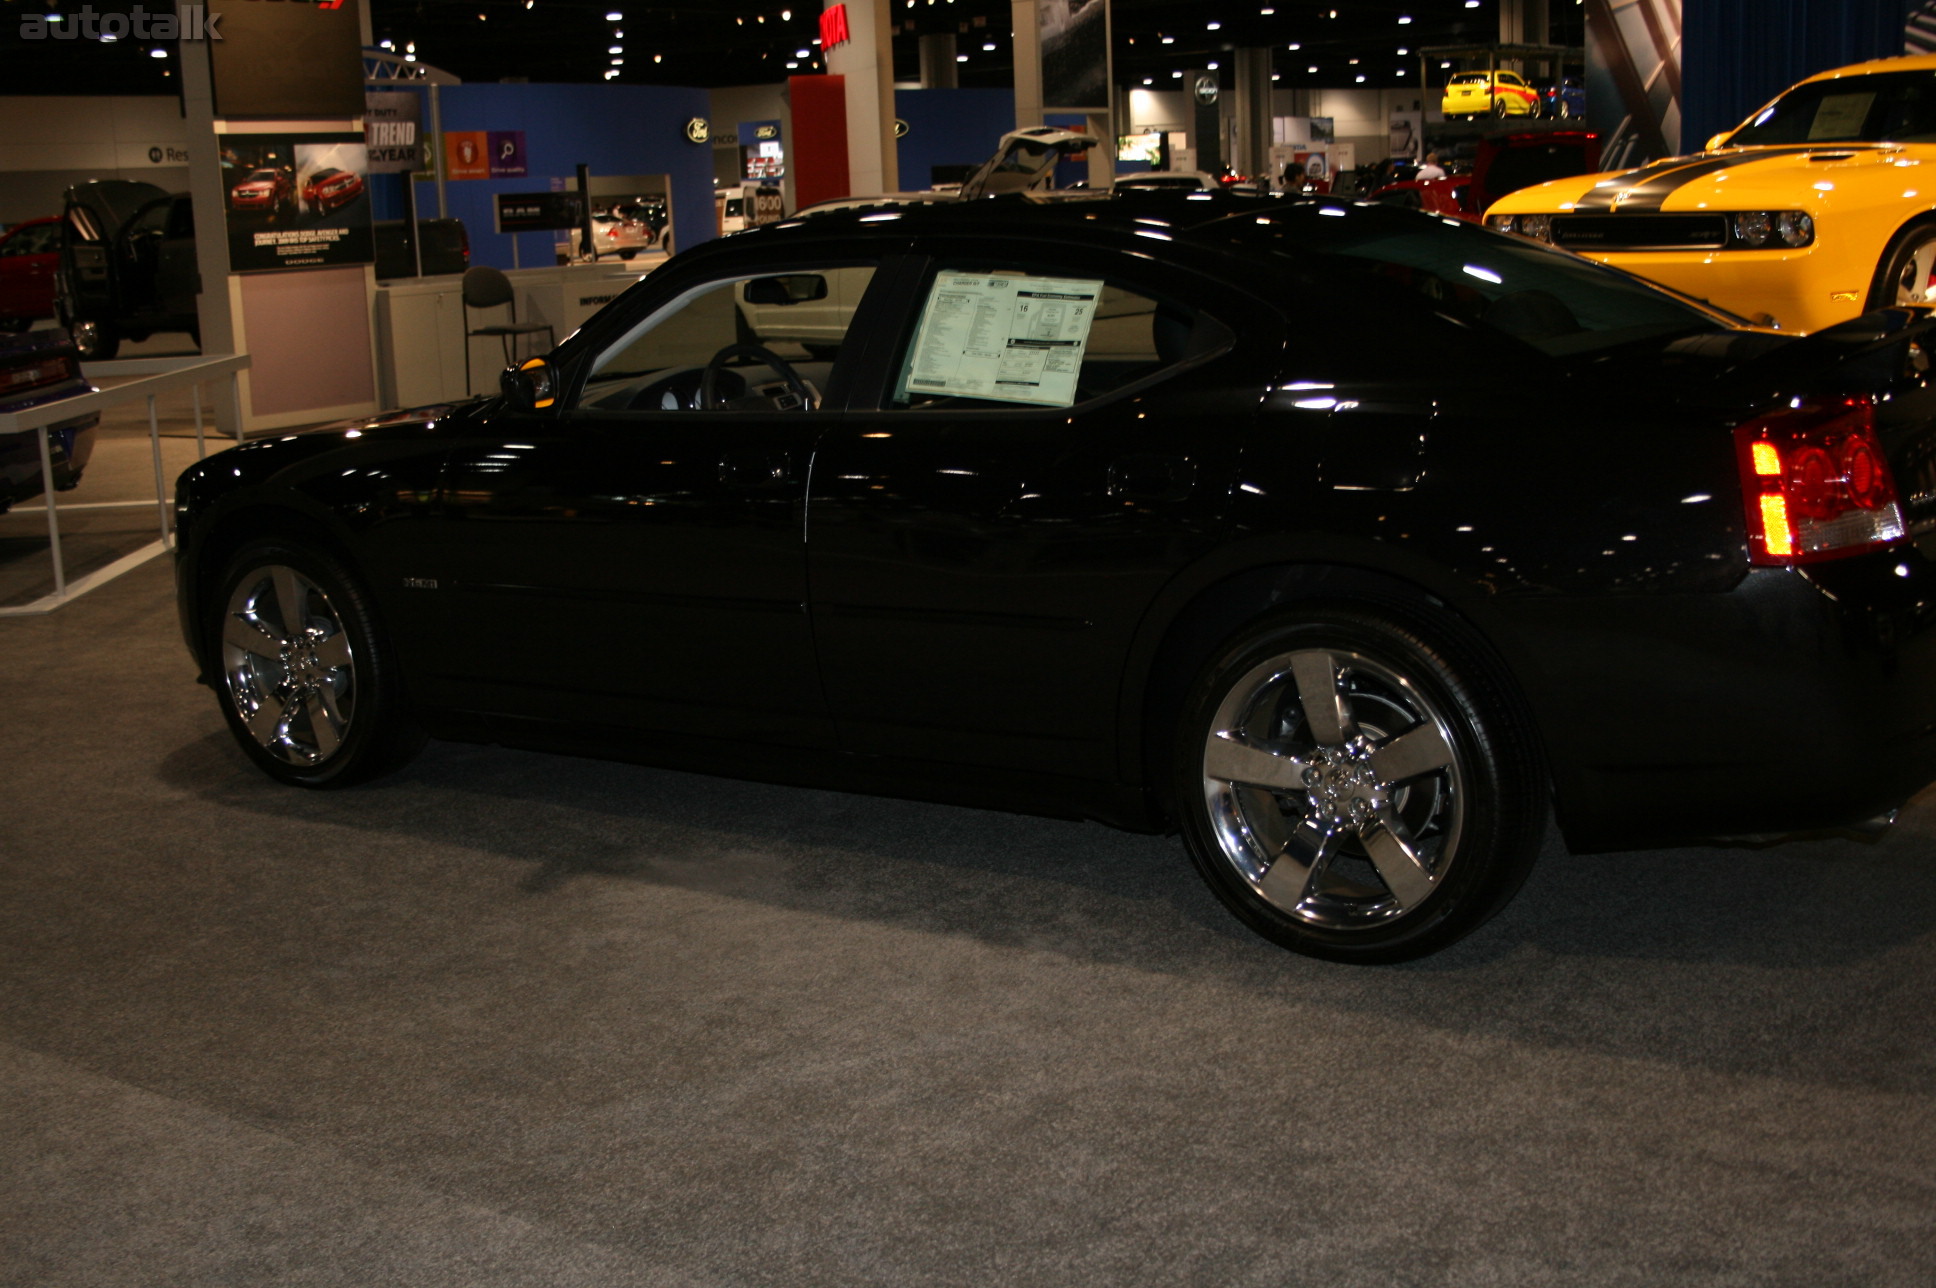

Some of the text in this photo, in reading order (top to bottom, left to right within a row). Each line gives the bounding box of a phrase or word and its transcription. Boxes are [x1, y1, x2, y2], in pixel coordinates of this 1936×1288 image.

[371, 122, 415, 145] TREND
[380, 149, 416, 160] YEAR
[1020, 304, 1028, 312] 16
